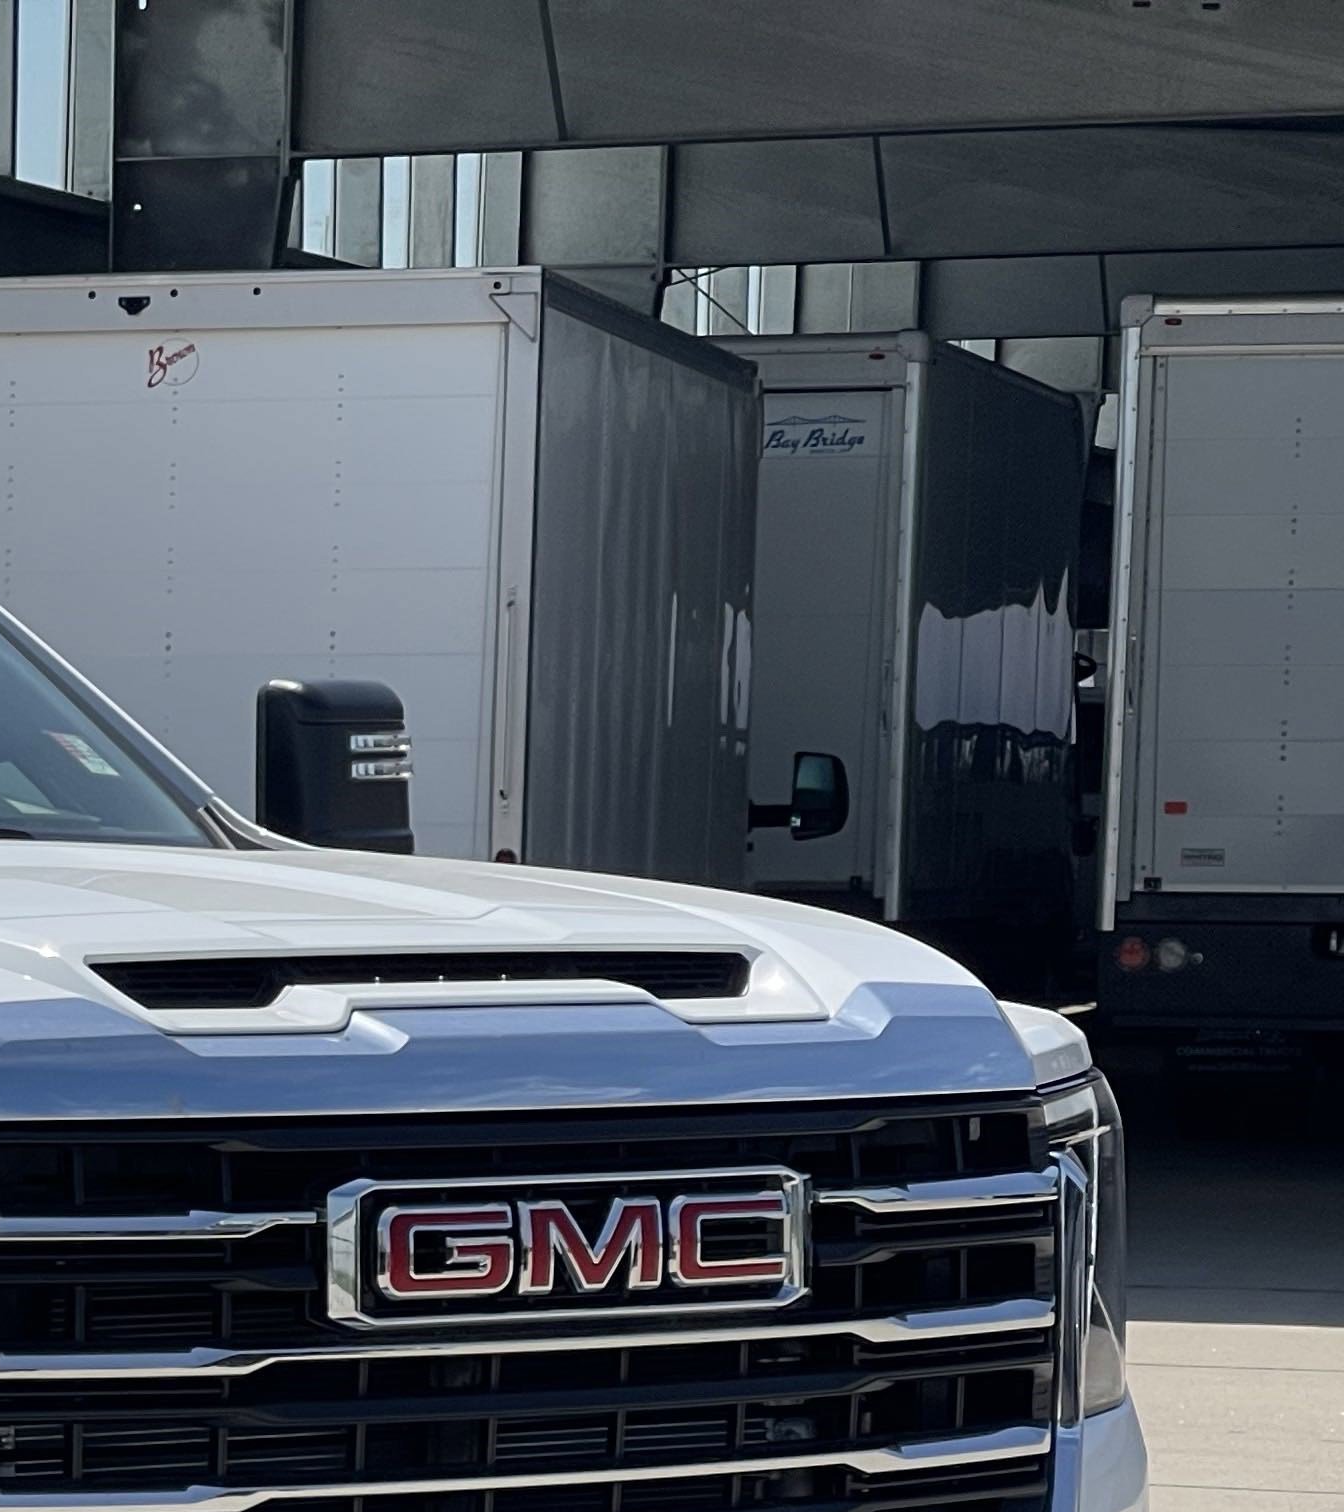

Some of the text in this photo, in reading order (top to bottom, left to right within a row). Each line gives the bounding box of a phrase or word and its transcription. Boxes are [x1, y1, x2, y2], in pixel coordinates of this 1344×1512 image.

[765, 428, 865, 455] Bay Bridge
[376, 1190, 792, 1299] GMC
